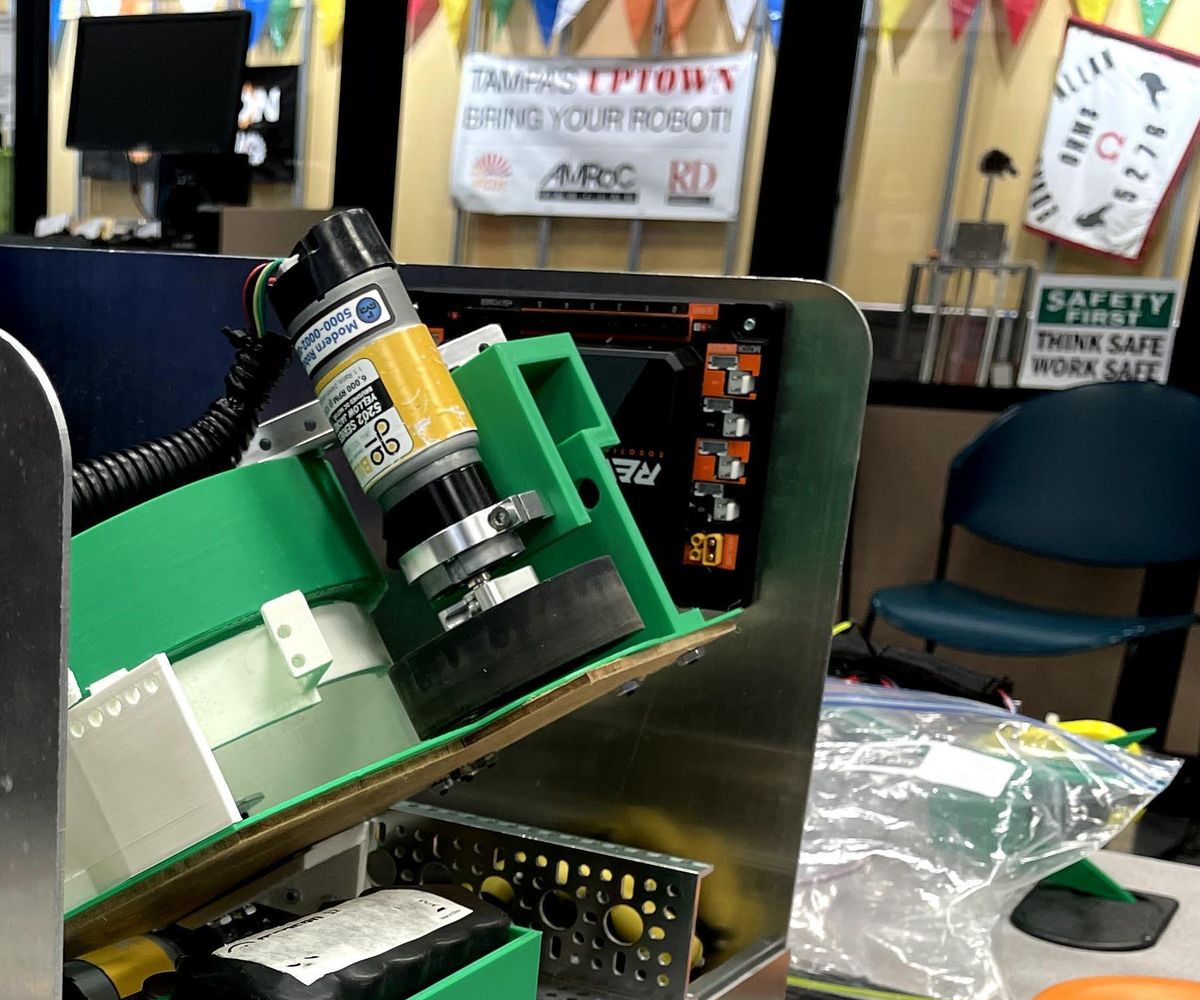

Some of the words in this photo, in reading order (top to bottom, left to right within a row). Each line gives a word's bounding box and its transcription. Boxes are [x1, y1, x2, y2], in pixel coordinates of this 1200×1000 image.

[586, 66, 735, 96] UPTOWN
[462, 105, 545, 132] BRING
[549, 105, 625, 133] YOUR
[628, 105, 733, 134] ROBOT!
[1045, 288, 1169, 316] SAFETY
[1064, 308, 1142, 327] FIRST
[316, 319, 359, 353] Modern
[1037, 331, 1102, 352] THINK
[1108, 332, 1166, 358] SAFE
[1031, 355, 1099, 380] WORK
[1103, 357, 1162, 383] SAFE
[332, 389, 347, 404] RPM
[346, 374, 368, 393] 6,000
[347, 392, 378, 419] YELLOW
[355, 401, 384, 426] 5202
[611, 458, 662, 486] RE
